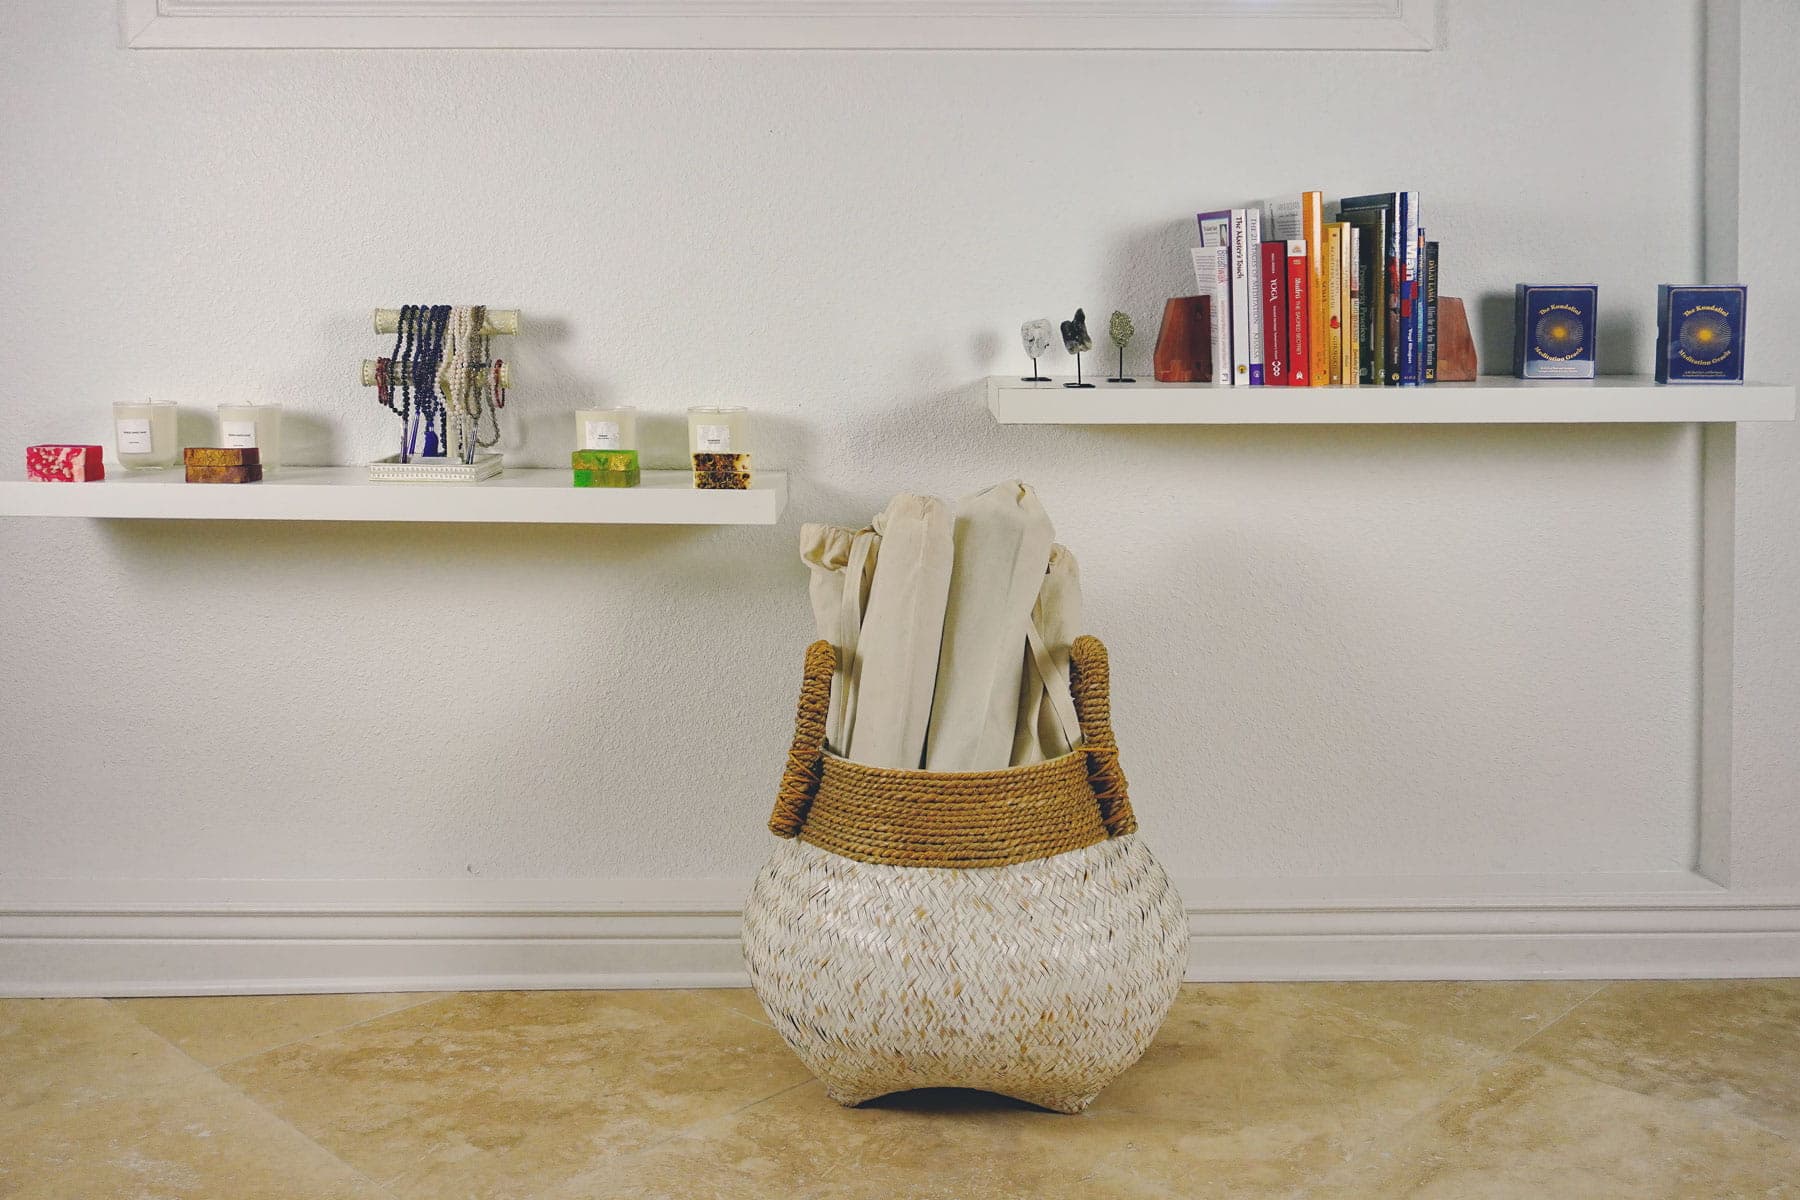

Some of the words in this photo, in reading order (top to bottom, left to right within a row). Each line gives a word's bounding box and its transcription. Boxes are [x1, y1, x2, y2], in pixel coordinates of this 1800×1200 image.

[1236, 231, 1244, 258] Master's
[1237, 260, 1245, 279] Touch
[1269, 279, 1278, 303] YOGA
[1294, 277, 1303, 299] Mudra
[1427, 283, 1435, 302] LAMA
[1539, 307, 1550, 316] The
[1550, 304, 1582, 316] Kundalini
[1683, 309, 1696, 317] The
[1696, 305, 1729, 317] Kundalini
[1534, 346, 1565, 362] Meditation
[1678, 349, 1711, 366] Meditation
